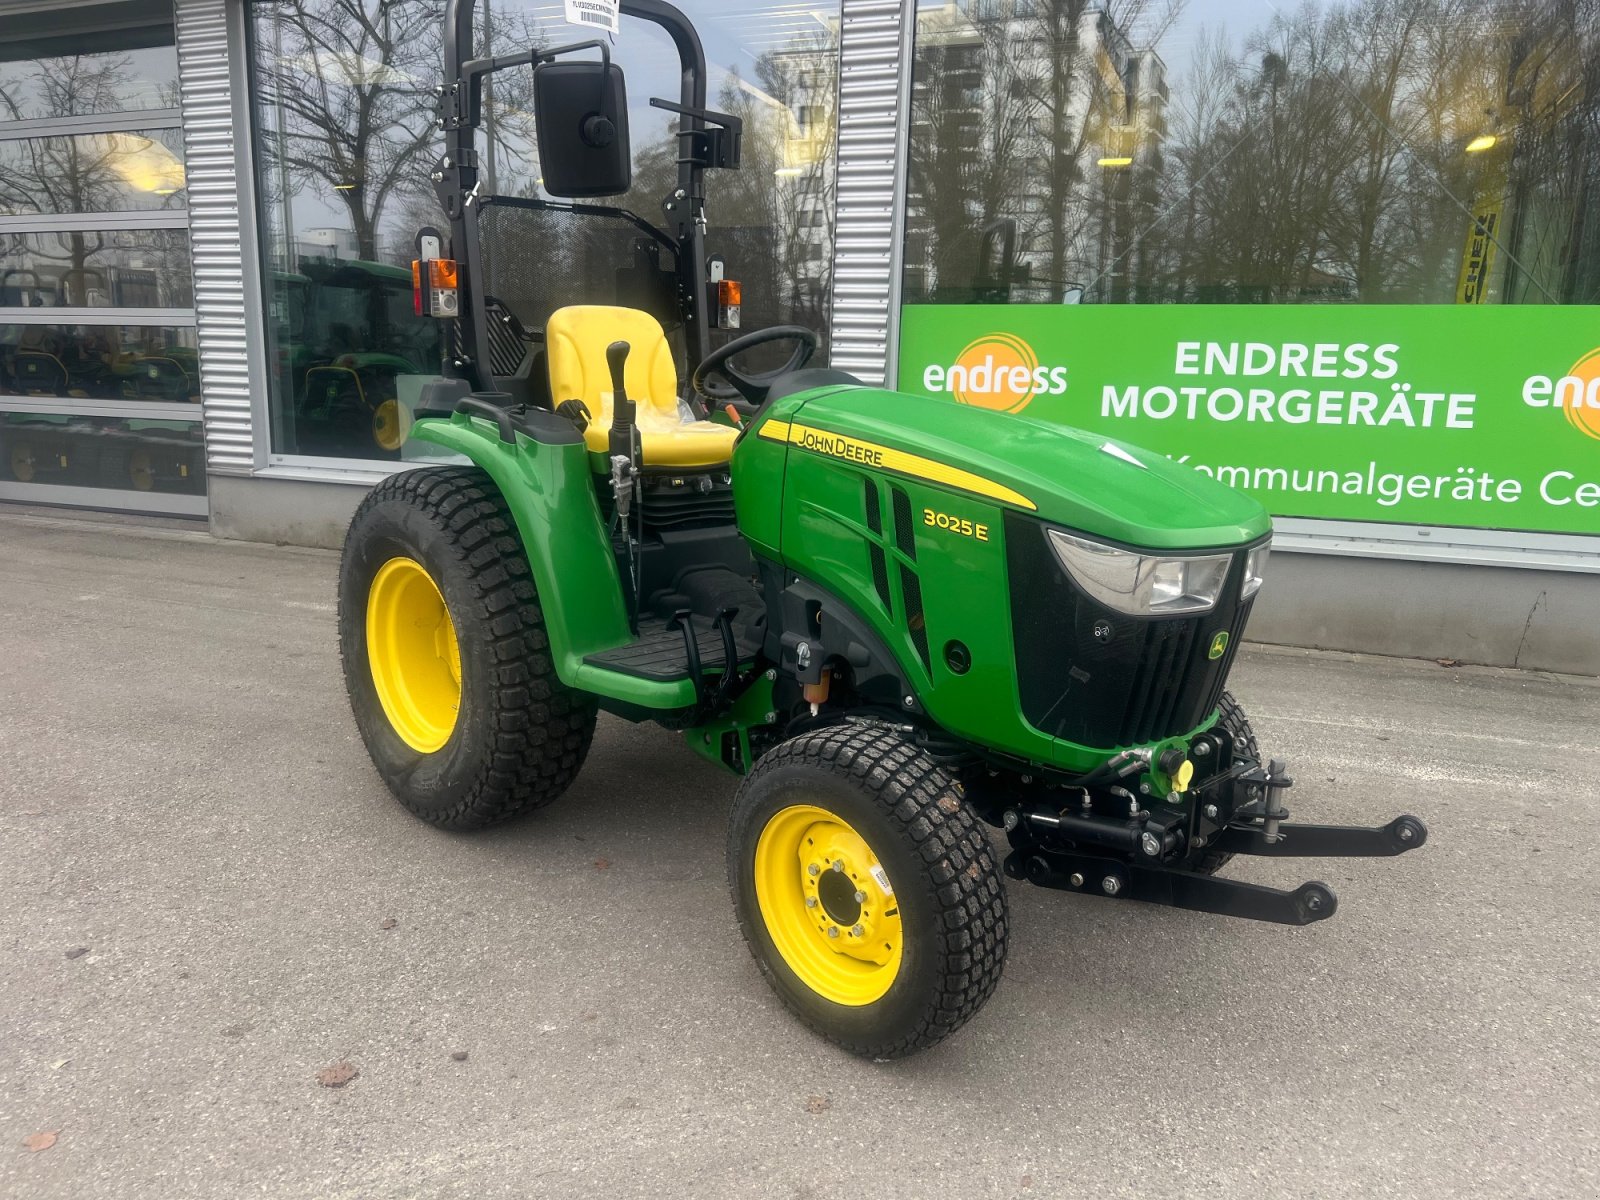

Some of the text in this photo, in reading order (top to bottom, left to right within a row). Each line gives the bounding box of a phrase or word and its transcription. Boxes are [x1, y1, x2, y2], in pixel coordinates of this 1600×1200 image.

[923, 354, 1068, 396] endress
[1174, 341, 1400, 379] ENDRESS
[1101, 383, 1476, 429] MOTORGERÄTE
[798, 429, 883, 466] JOHN DEERE
[923, 509, 989, 541] 3025 E
